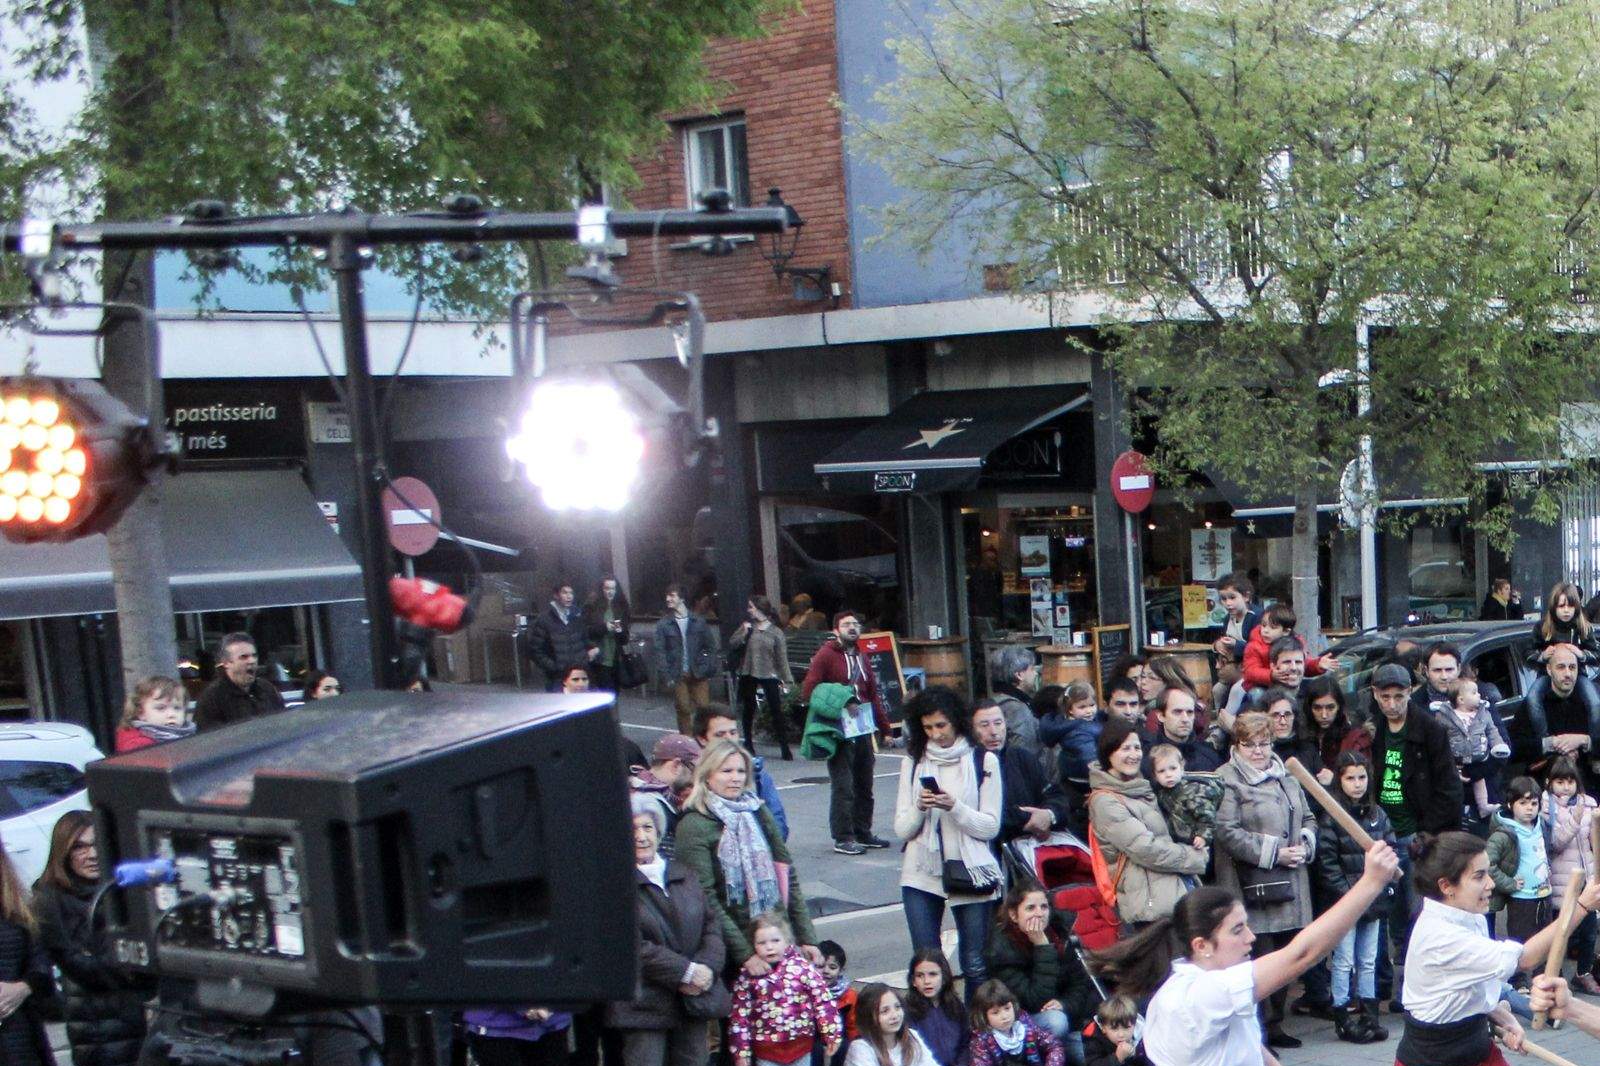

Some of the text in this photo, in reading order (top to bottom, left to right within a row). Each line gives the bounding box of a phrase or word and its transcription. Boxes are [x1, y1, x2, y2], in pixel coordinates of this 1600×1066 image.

[174, 403, 277, 427] pastisseria
[188, 431, 227, 450] més
[878, 475, 911, 487] SPOON
